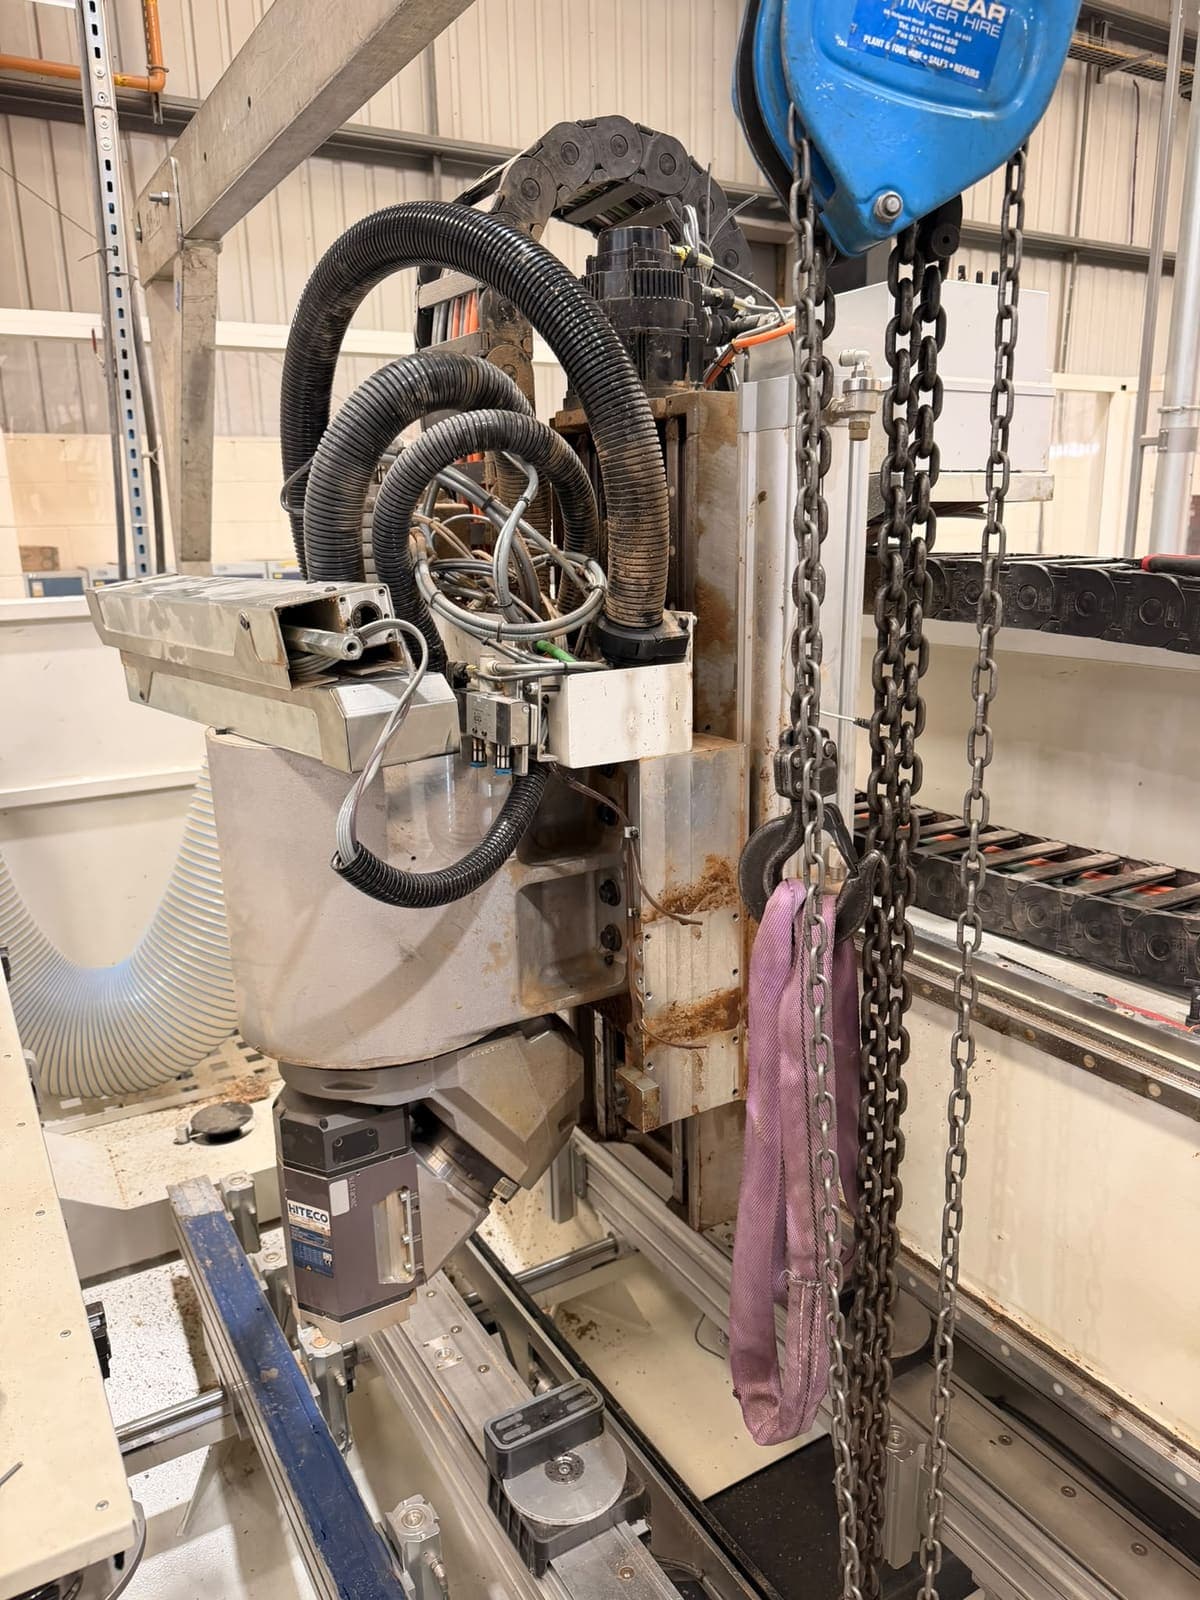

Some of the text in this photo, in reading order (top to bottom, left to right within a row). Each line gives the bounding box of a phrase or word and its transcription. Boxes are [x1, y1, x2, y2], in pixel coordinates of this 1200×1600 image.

[963, 15, 1002, 39] HIRE
[863, 34, 885, 48] PLANT
[953, 63, 980, 79] REPAIRS
[288, 1203, 329, 1224] HITECO
